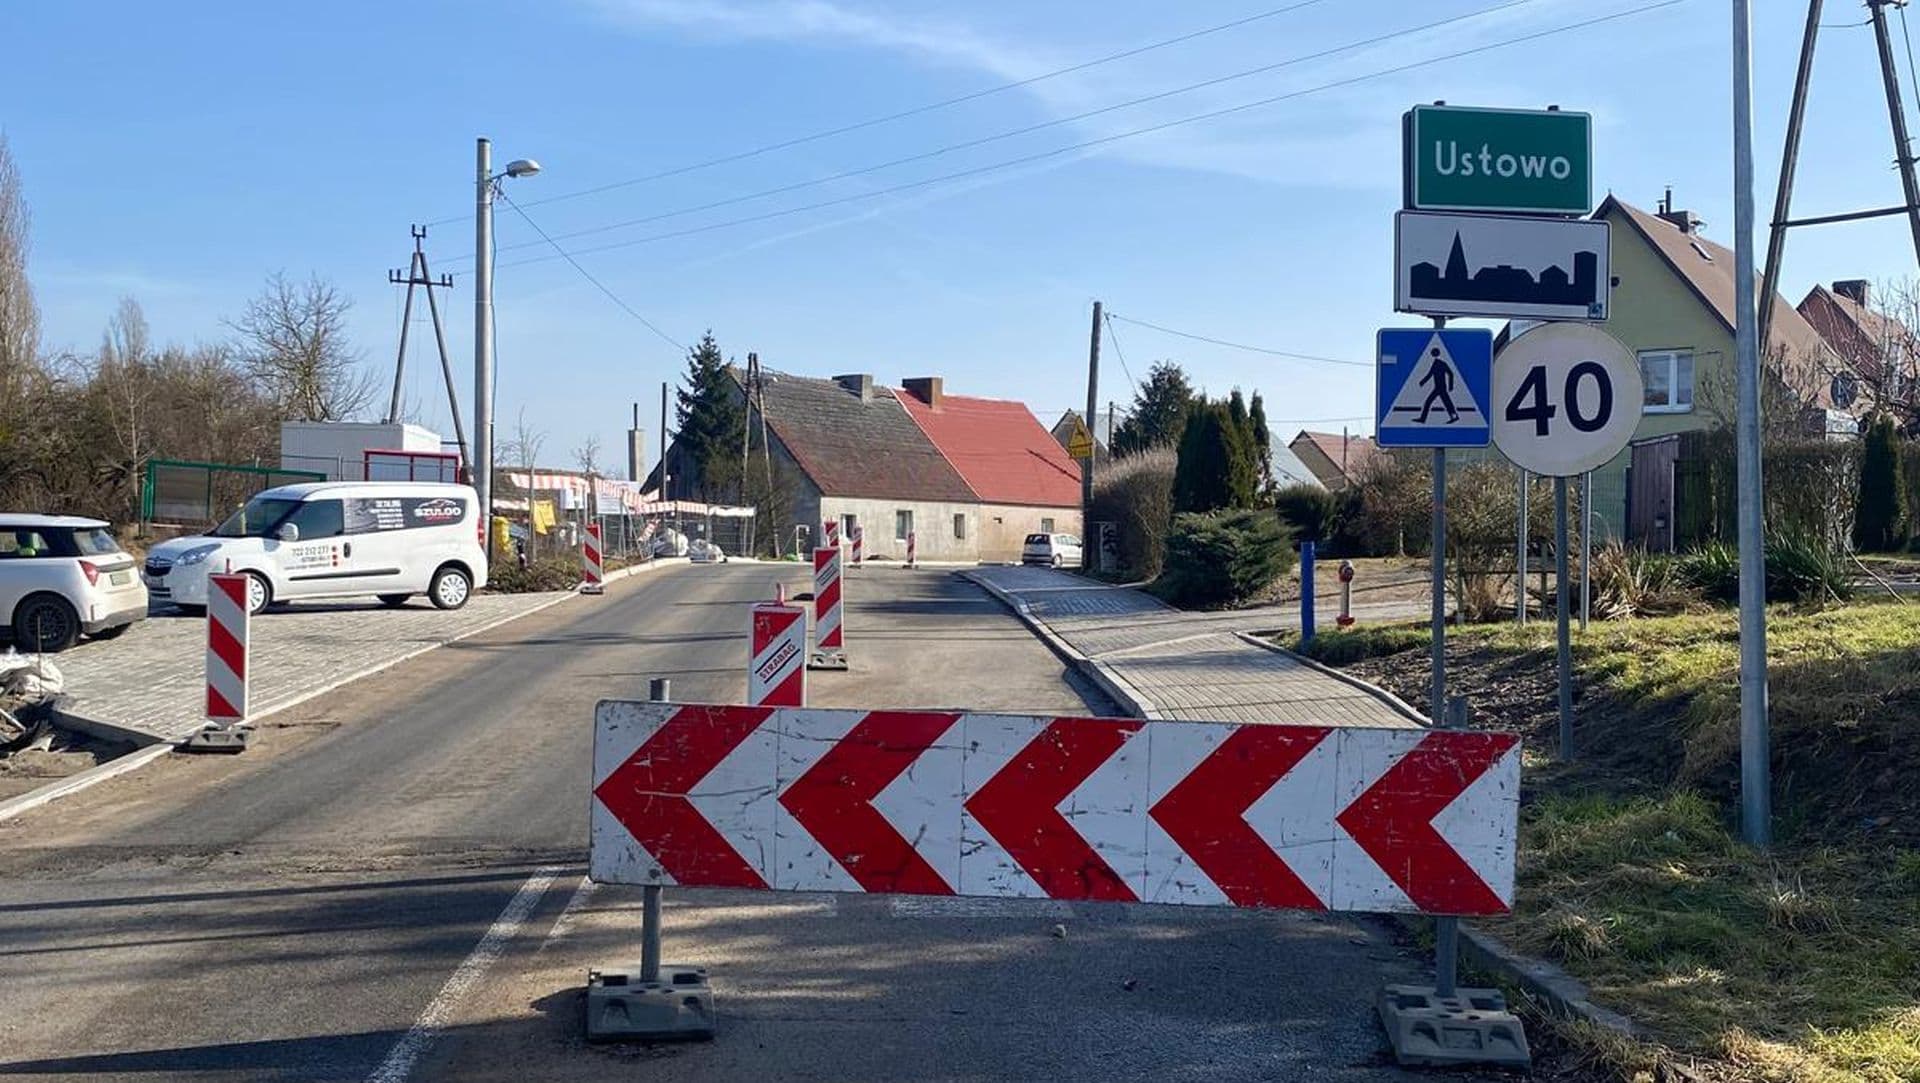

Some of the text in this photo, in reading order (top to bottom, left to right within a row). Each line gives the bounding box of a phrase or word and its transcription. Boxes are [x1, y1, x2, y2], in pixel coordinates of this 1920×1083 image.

[1435, 140, 1571, 180] Ustowo
[1505, 360, 1613, 437] 40
[759, 643, 796, 679] STRABAG
